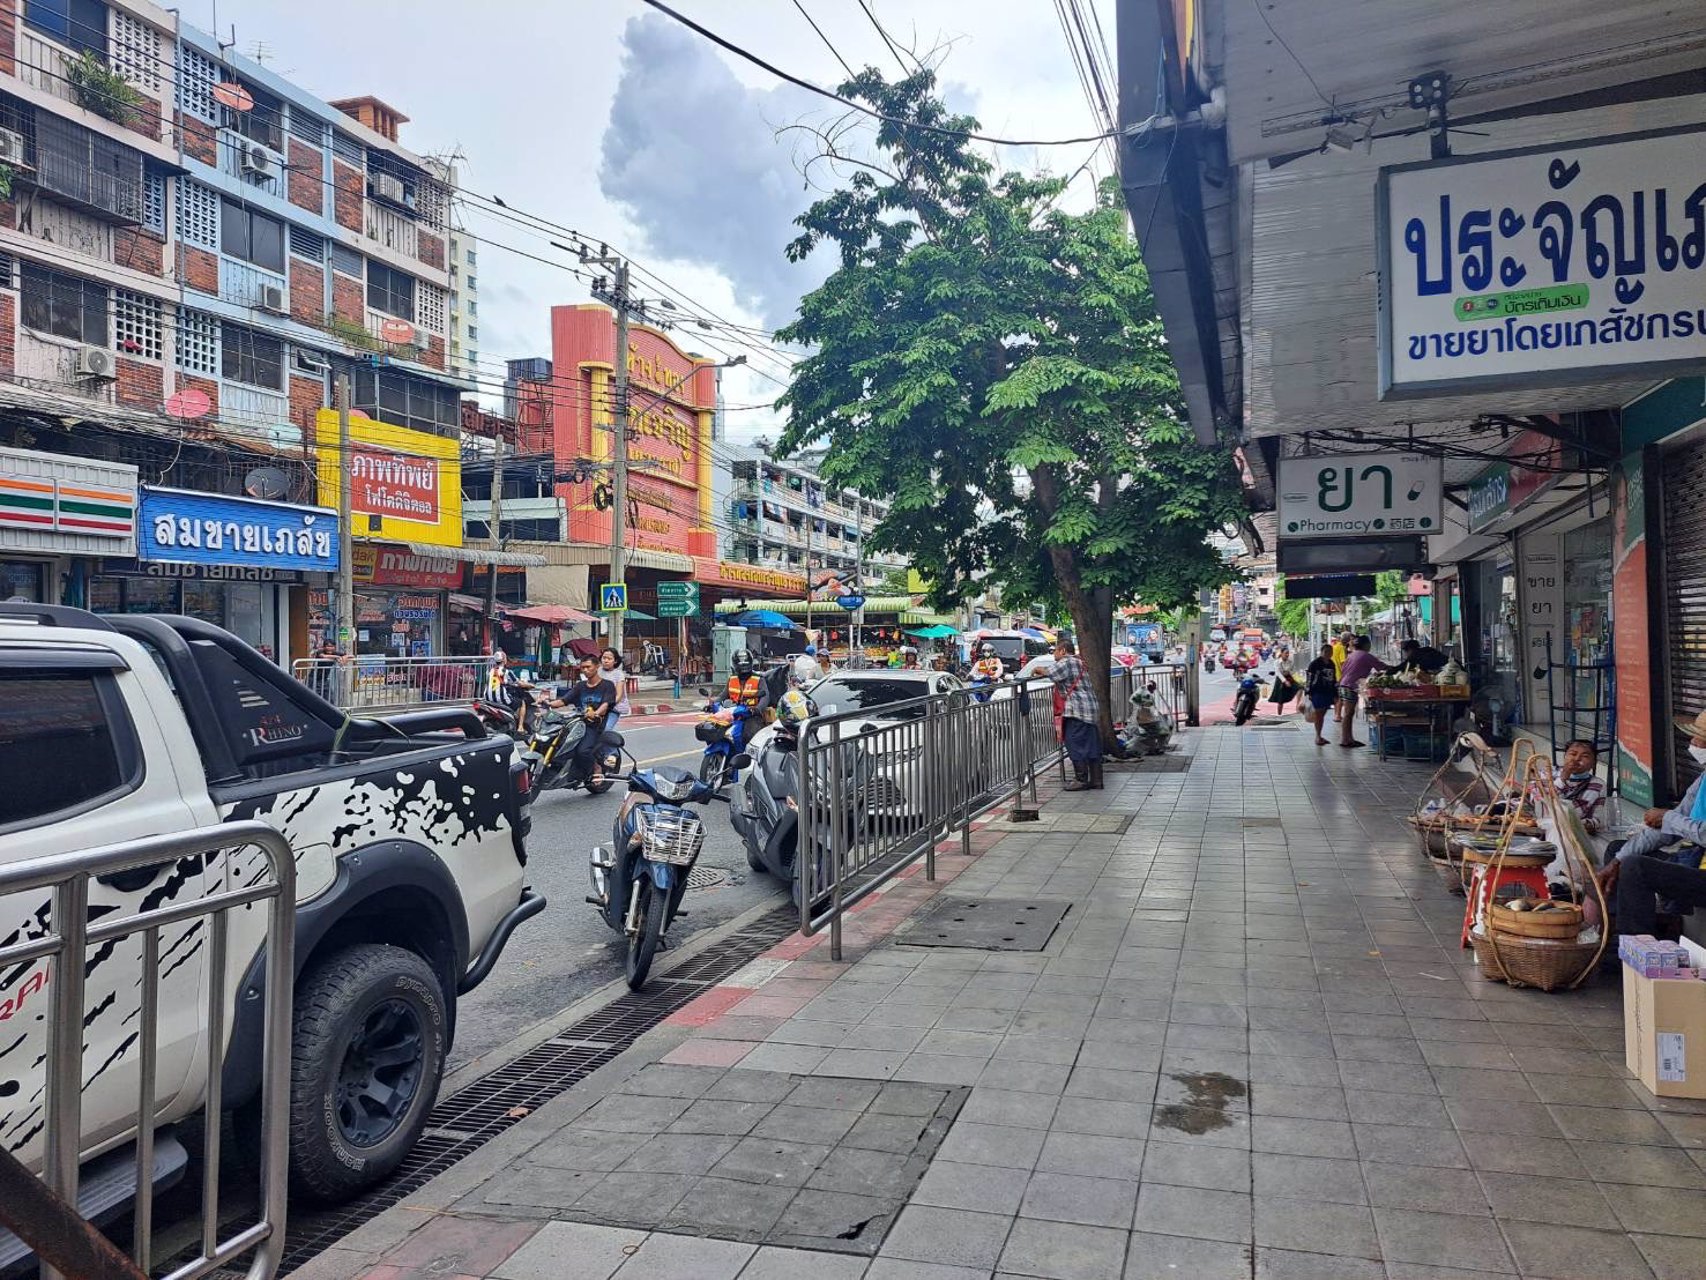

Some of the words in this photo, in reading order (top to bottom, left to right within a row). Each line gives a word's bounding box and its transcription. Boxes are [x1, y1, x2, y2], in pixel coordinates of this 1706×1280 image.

[1408, 308, 1706, 361] ขายยาโดยเภสัชกร
[1317, 465, 1393, 512] ยา
[1300, 518, 1371, 533] Pharmacy
[1527, 576, 1556, 588] ขาย
[1532, 603, 1552, 614] ยา
